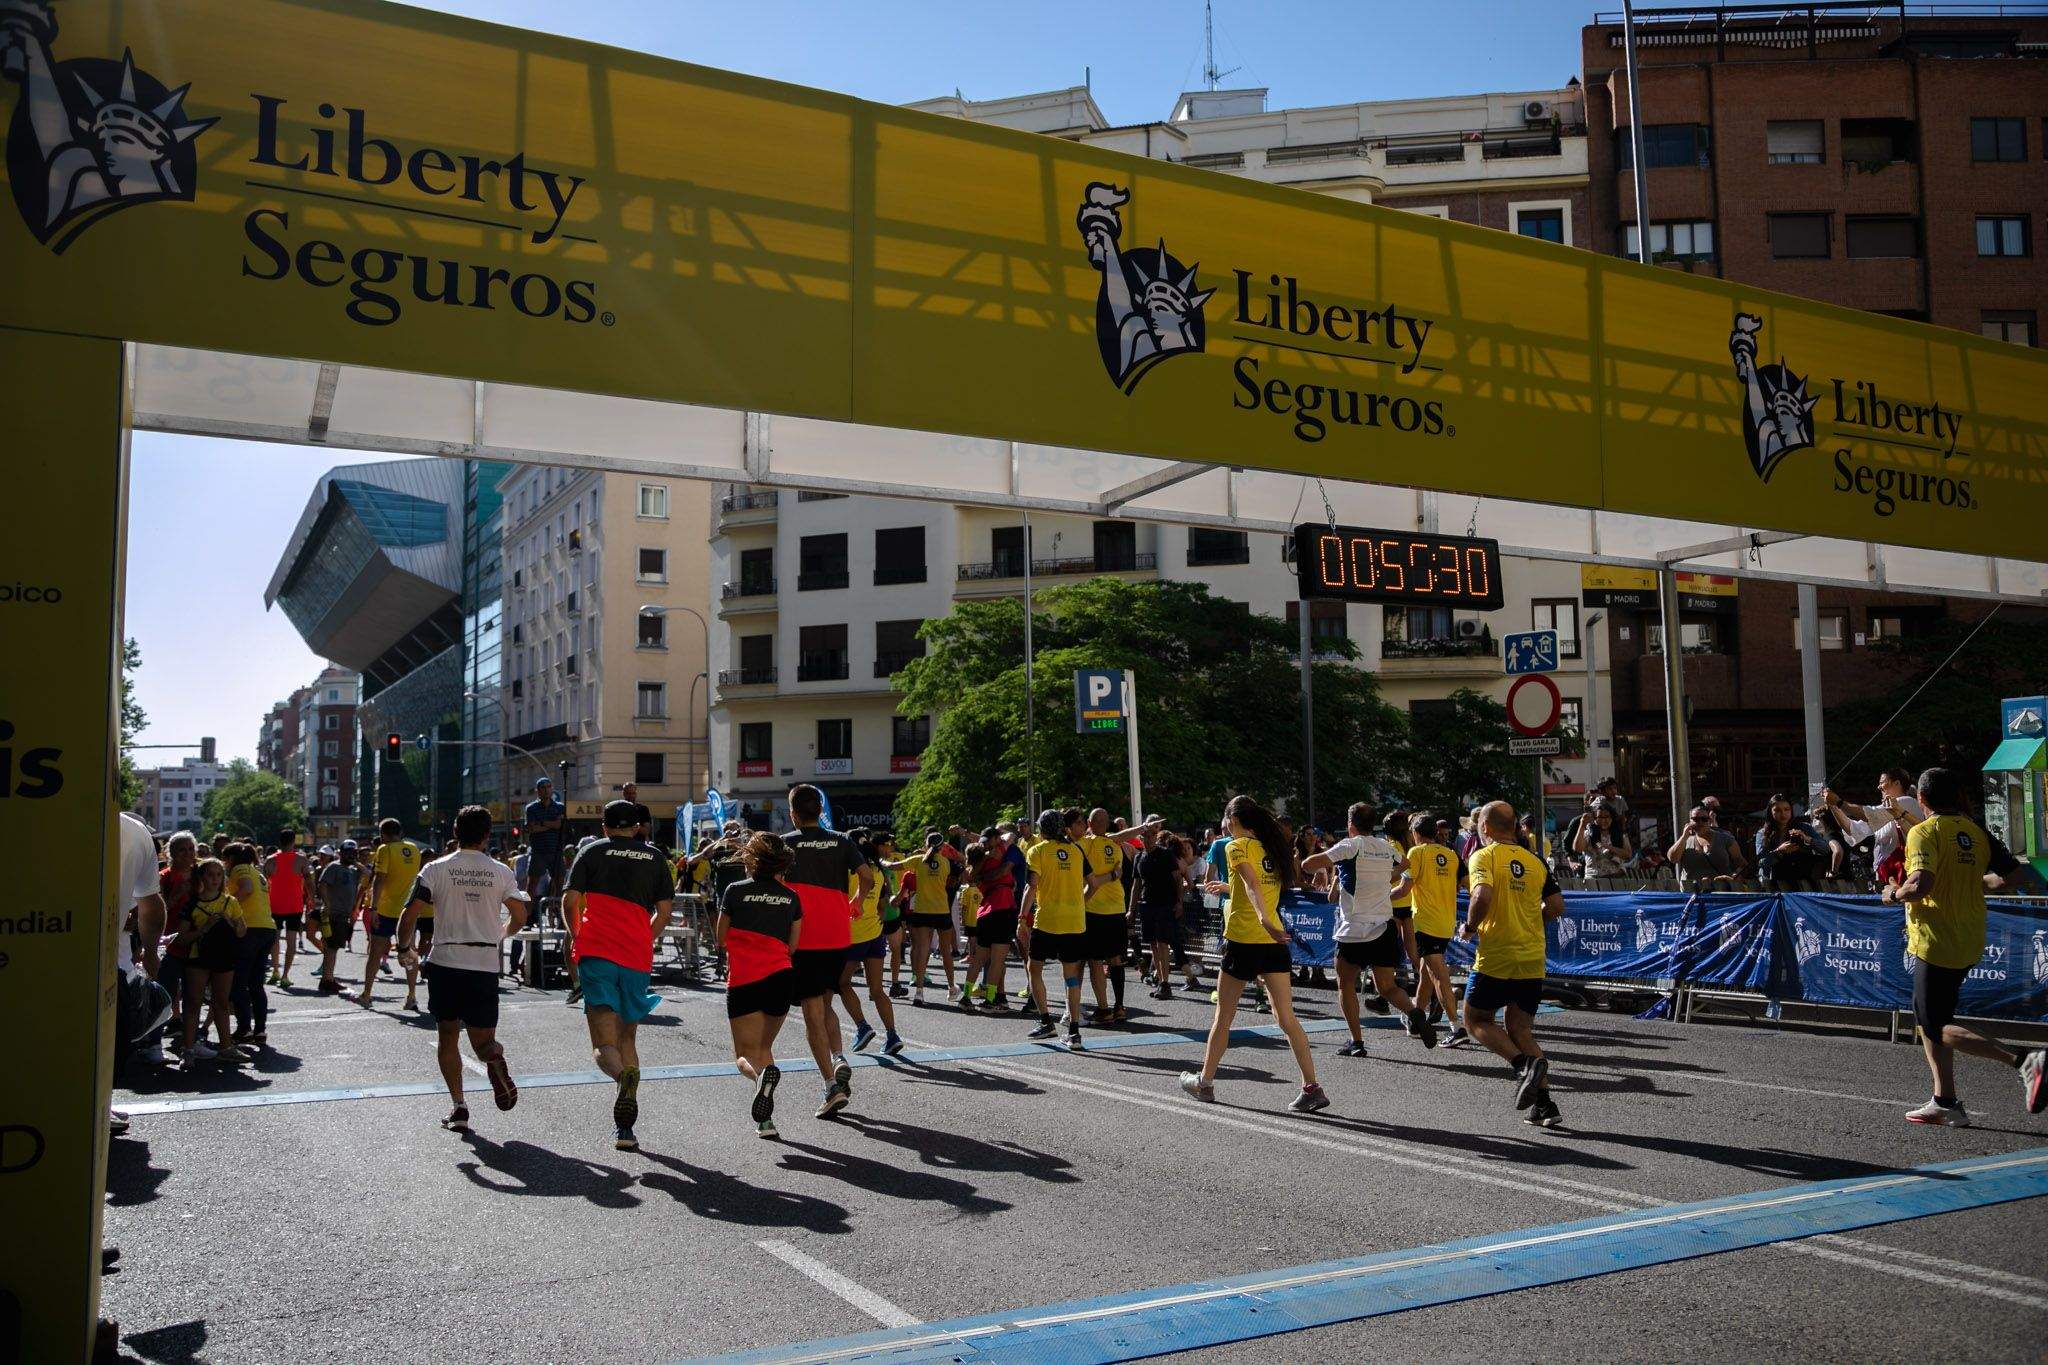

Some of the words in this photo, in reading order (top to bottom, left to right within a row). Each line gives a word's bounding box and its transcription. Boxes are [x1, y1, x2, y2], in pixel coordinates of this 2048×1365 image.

[249, 92, 586, 244] Liberty
[1232, 268, 1434, 374] Liberty
[1830, 378, 1963, 460] Liberty
[1614, 595, 1640, 604] MADRID
[1089, 675, 1112, 706] P
[1091, 719, 1119, 729] LIBRE
[449, 868, 494, 878] Voluntarios
[1512, 863, 1522, 875] 13
[1296, 913, 1324, 930] Liberty
[1581, 918, 1621, 937] Liberty
[1580, 938, 1622, 956] Seguros
[1826, 932, 1881, 956] Liberty
[1825, 953, 1882, 975] Seguros
